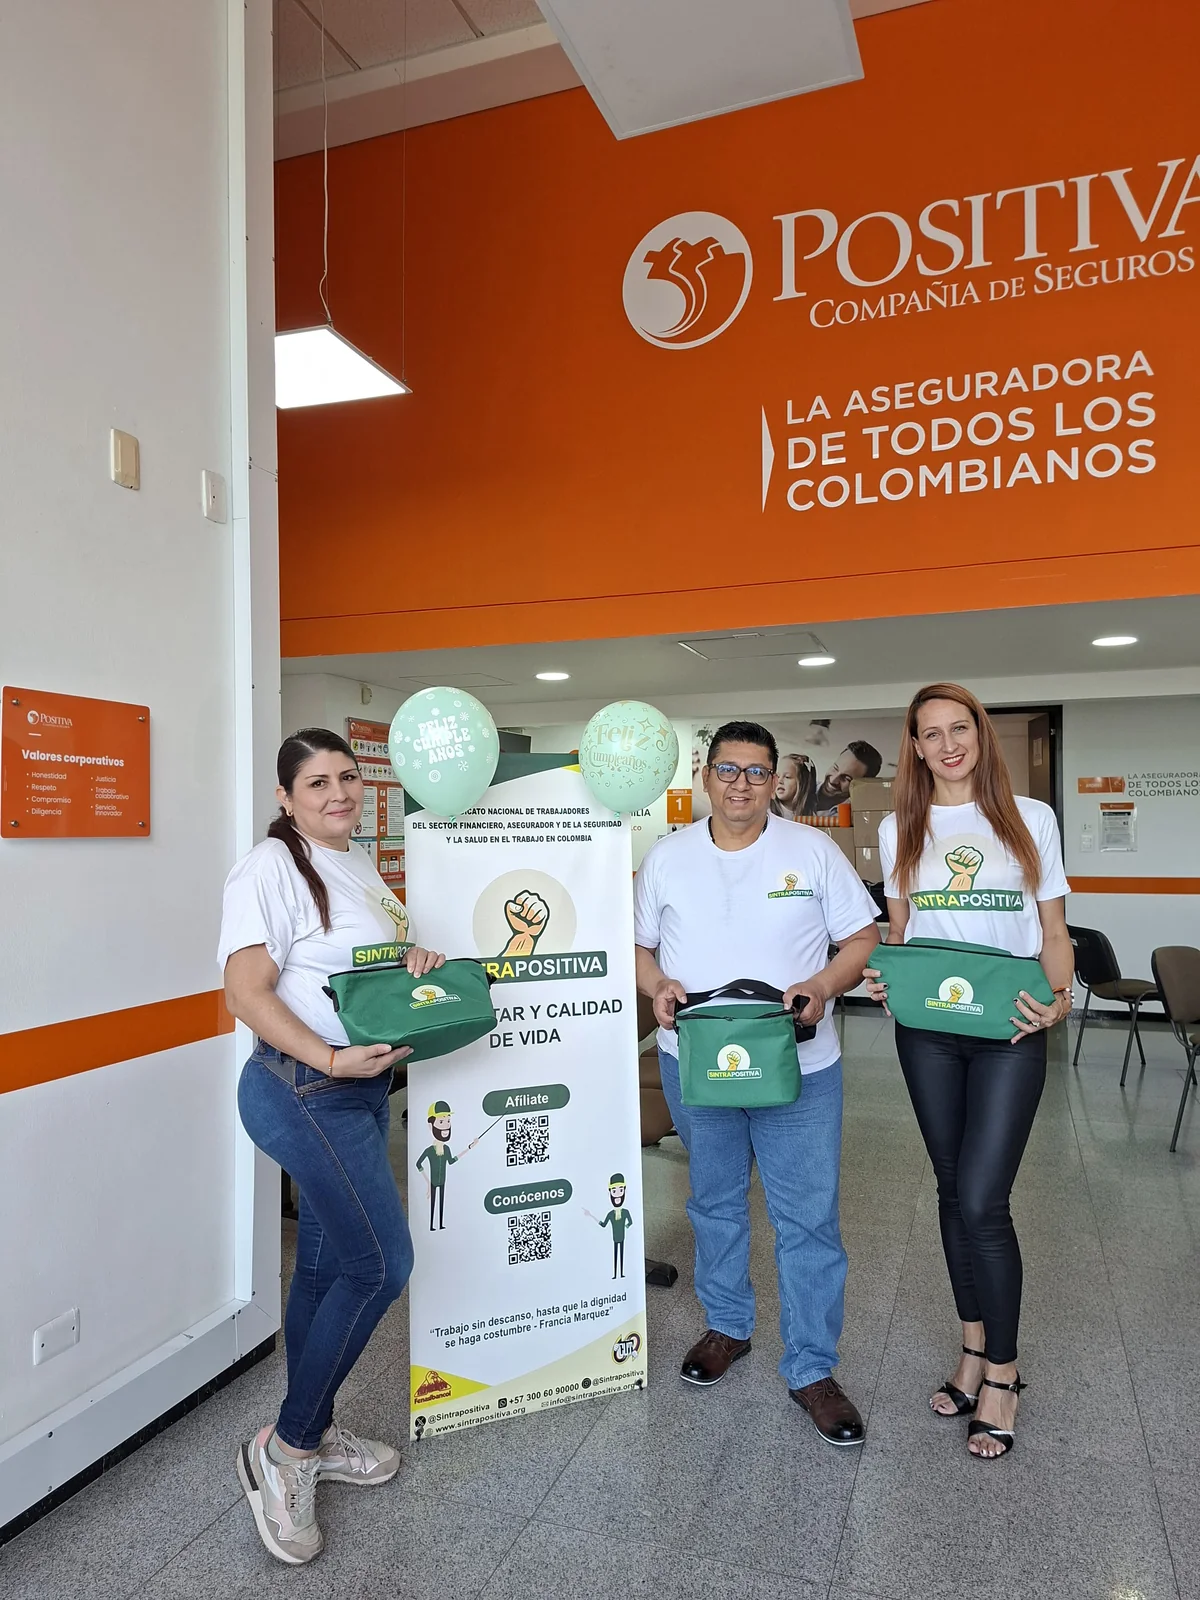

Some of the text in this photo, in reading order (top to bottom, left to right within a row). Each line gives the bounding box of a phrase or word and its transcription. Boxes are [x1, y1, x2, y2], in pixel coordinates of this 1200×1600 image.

[989, 276, 1026, 301] DE
[1034, 247, 1195, 294] SEGUROS
[787, 350, 1154, 424] LA ASEGURADORA
[788, 392, 1156, 469] DE TODOS LOS
[787, 439, 1156, 511] COLOMBIANOS
[40, 713, 73, 727] POSITIVA
[418, 715, 459, 737] FELIZ
[413, 727, 471, 752] CUMPLE
[595, 723, 651, 751] Feliz
[22, 749, 125, 767] Valores corporativos
[589, 744, 648, 772] Cumpleaños
[31, 772, 67, 780] Honestidad
[1145, 780, 1181, 788] TODOS
[31, 783, 57, 792] Respeto
[1128, 789, 1200, 797] COLOMBIANO
[31, 796, 72, 804] Compromiso
[676, 797, 682, 811] 1
[31, 808, 62, 816] Diligencia
[536, 807, 590, 815] TRABAJADORES
[428, 821, 458, 829] SECTOR
[460, 822, 506, 830] FINANCIERO,
[507, 821, 555, 829] ASEGURADOR
[583, 820, 622, 828] SEGURIDAD
[482, 957, 603, 979] RAPOSITIVA
[412, 995, 458, 1008] SINTRAPOSITIVA
[530, 1004, 541, 1020] Y
[546, 999, 623, 1018] CALIDAD
[927, 999, 981, 1013] SINTRAPOSITIVA
[490, 1028, 562, 1048] DE VIDA
[708, 1069, 760, 1079] SINTRAPOSITIVA
[492, 1186, 565, 1208] Conócenos
[472, 1318, 486, 1331] sin
[488, 1310, 534, 1327] descanso,
[536, 1307, 560, 1318] hasta
[562, 1303, 578, 1313] que
[580, 1299, 588, 1309] la
[590, 1292, 627, 1308] dignidad
[445, 1339, 456, 1349] se
[458, 1334, 481, 1347] haga
[483, 1323, 532, 1341] costumbre
[539, 1316, 571, 1330] Francia
[428, 1369, 645, 1424] @Sintrapositiva +57 300 60 90000 @Sintrapositiva
[435, 1383, 636, 1433] www.sintrapositiva.org info@sintrapositiva.org
